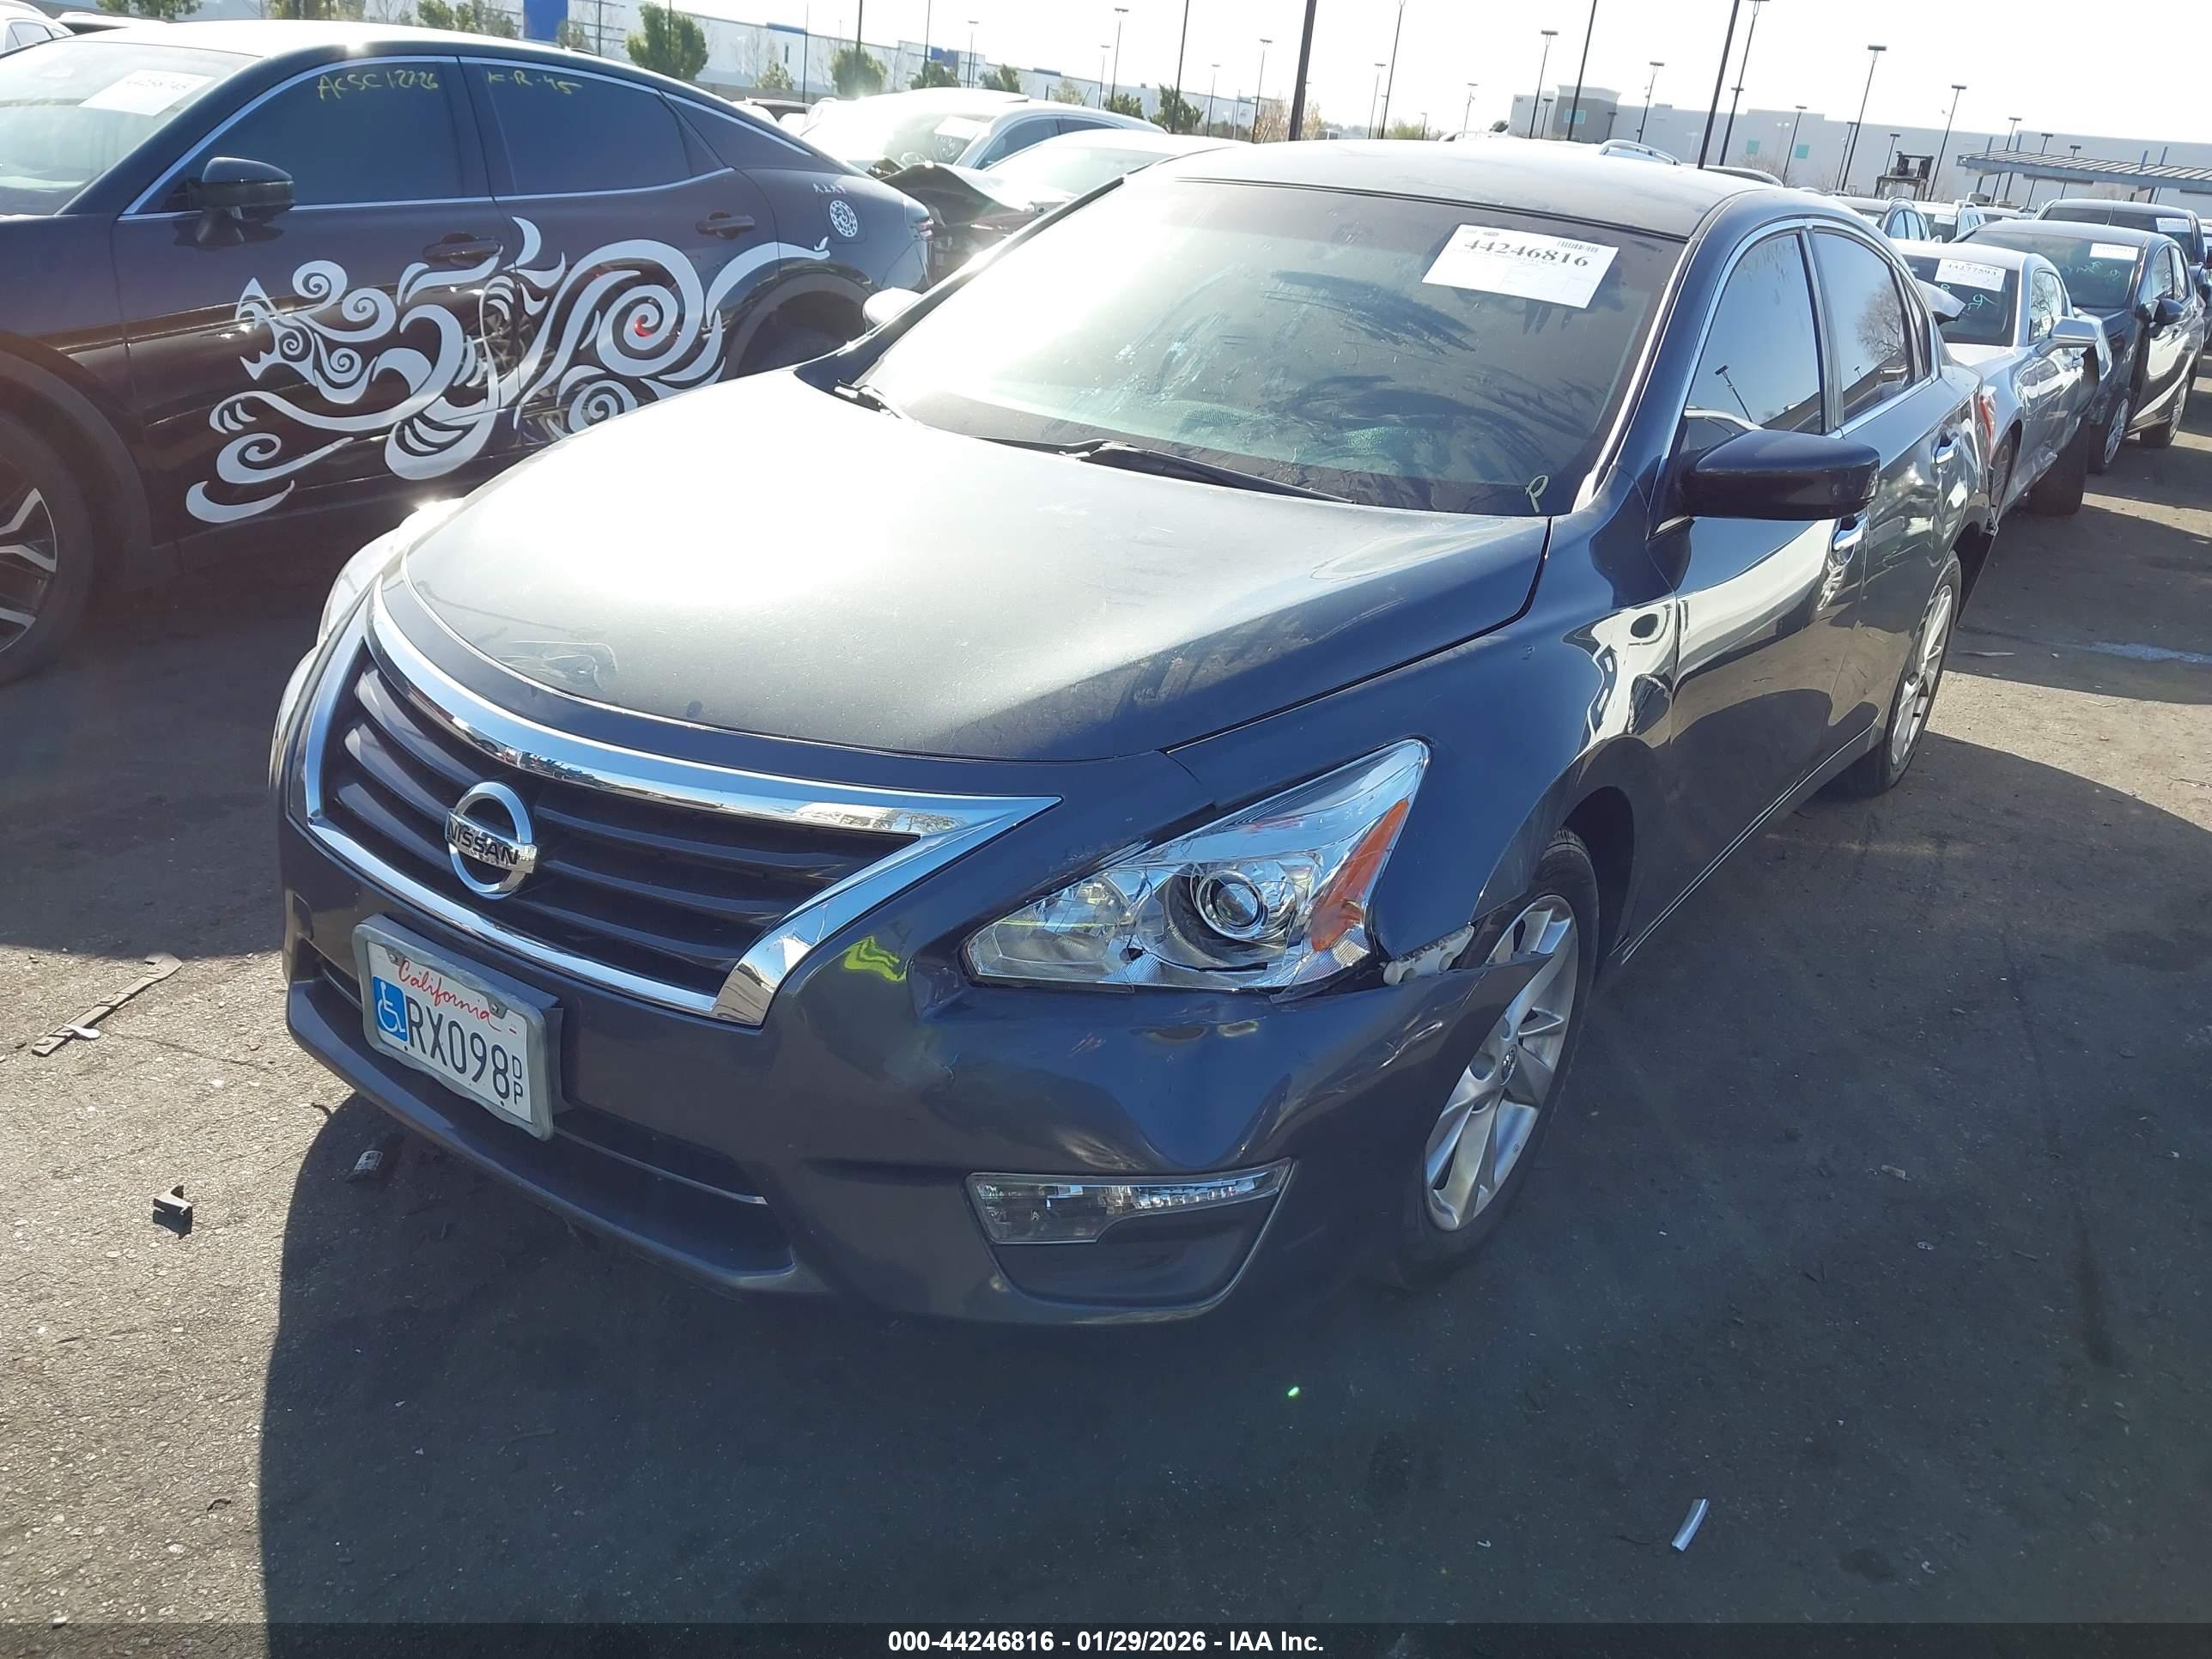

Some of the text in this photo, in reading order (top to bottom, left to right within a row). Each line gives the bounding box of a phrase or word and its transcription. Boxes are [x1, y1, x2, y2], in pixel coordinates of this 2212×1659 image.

[1464, 240, 1590, 267] 44246816
[448, 815, 520, 866] NISSAN
[398, 960, 501, 1031] California
[405, 995, 510, 1100] RX098
